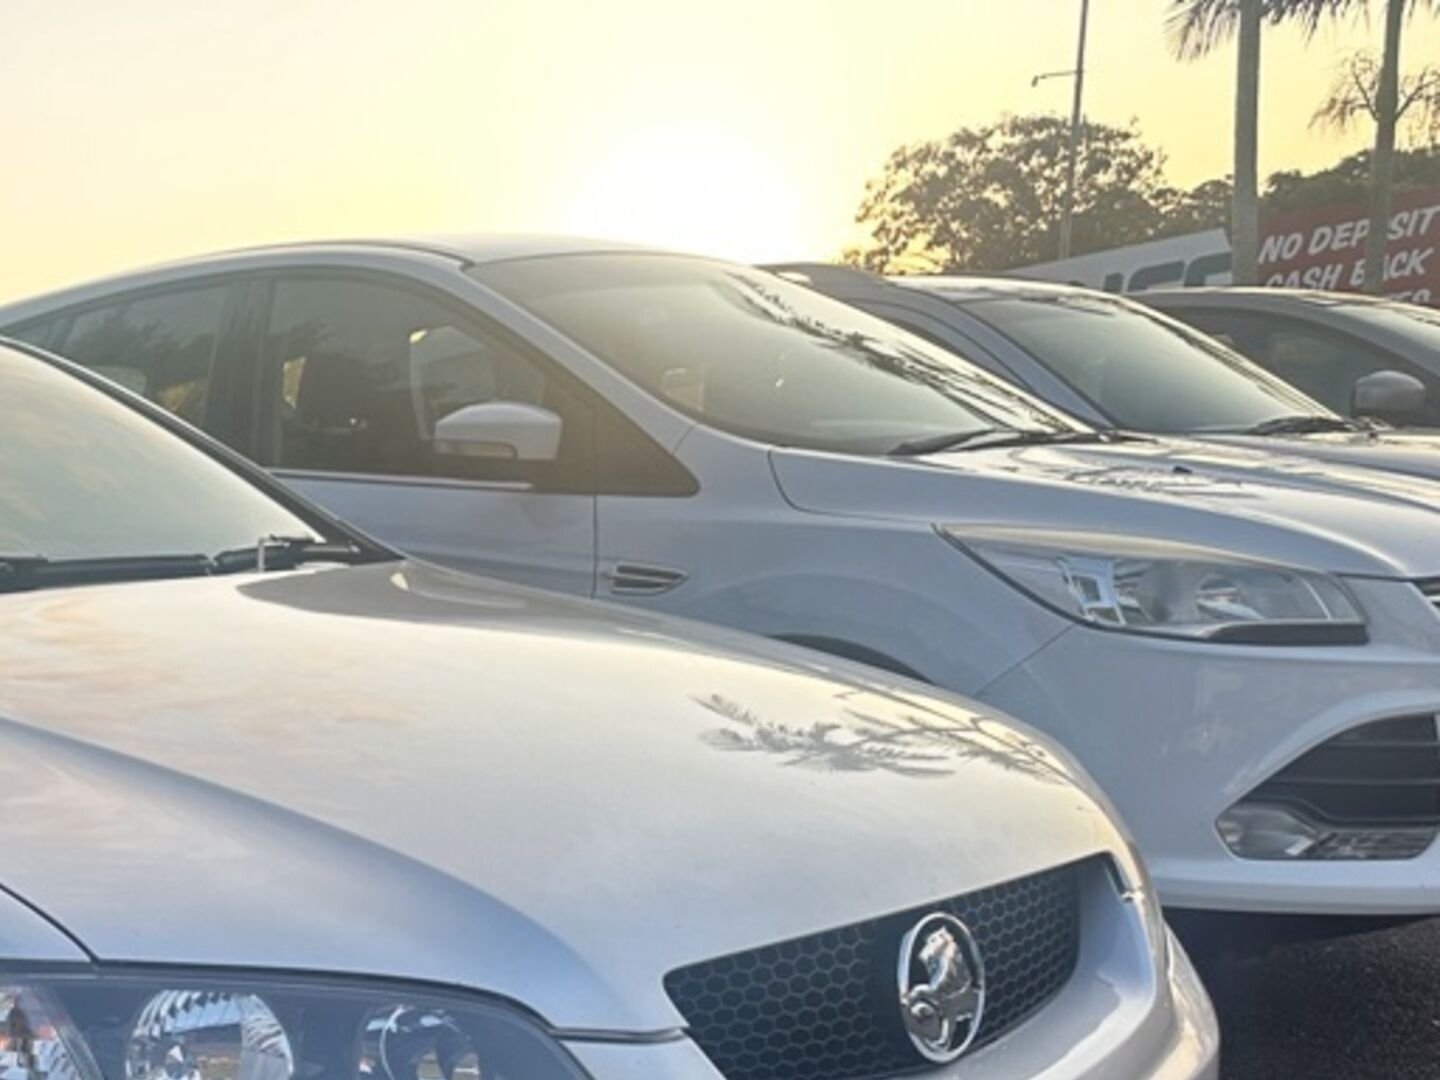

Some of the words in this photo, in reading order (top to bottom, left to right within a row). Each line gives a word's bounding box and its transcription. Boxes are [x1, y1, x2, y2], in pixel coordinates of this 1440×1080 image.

[1258, 232, 1303, 265] NO
[1308, 204, 1440, 256] DEPSIT
[1265, 263, 1344, 290] CASH
[1349, 247, 1435, 286] BCK
